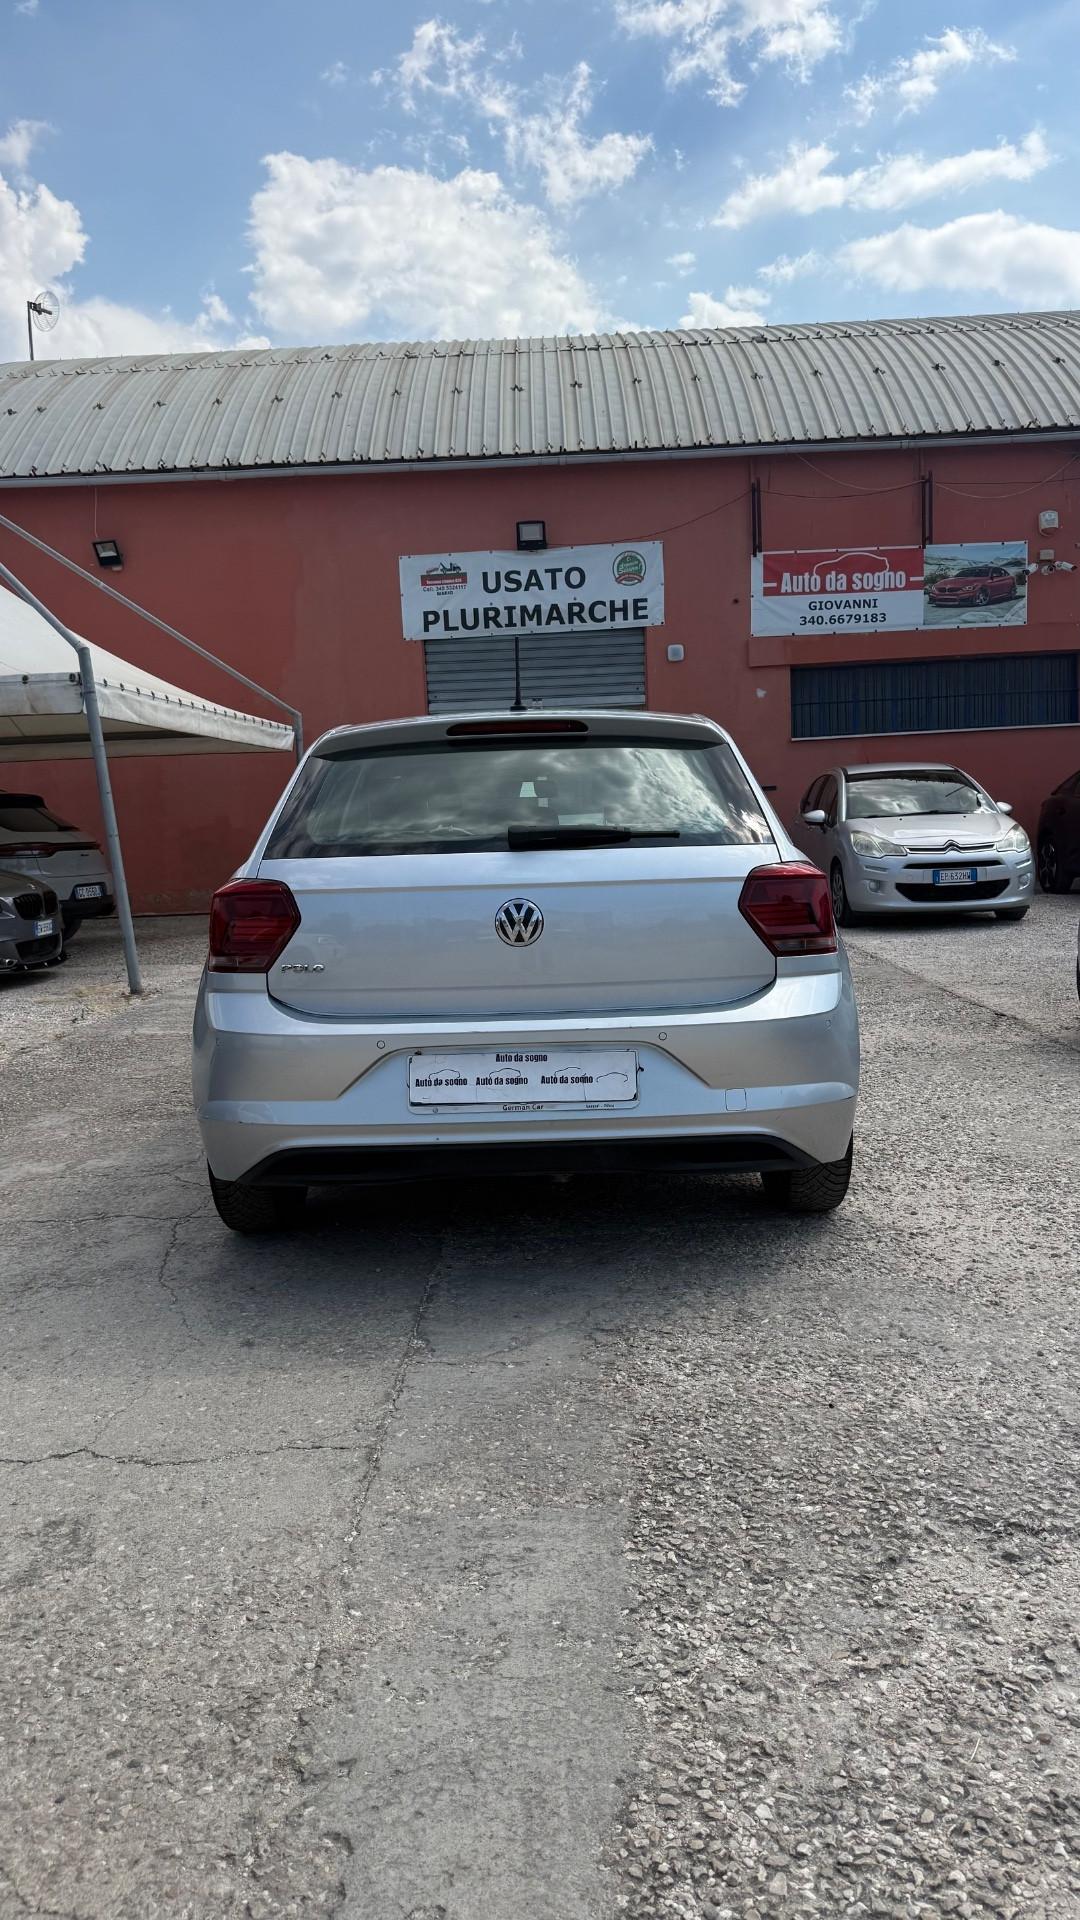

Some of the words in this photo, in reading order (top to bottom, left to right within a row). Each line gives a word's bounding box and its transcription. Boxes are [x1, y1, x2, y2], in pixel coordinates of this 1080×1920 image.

[482, 566, 586, 594] USATO
[781, 572, 821, 593] Auto
[825, 571, 847, 591] da
[851, 570, 906, 591] sogno
[808, 598, 878, 611] GIOVANNI
[423, 598, 649, 633] PLURIMARCHE
[799, 612, 887, 626] 340.6679183
[495, 1053, 512, 1062] Auto
[514, 1053, 523, 1062] da
[525, 1053, 548, 1063] sogno
[415, 1078, 432, 1087] Auto
[434, 1077, 442, 1086] da
[444, 1077, 468, 1087] sogno
[476, 1076, 493, 1086] Auto
[494, 1076, 504, 1085] da
[505, 1076, 528, 1087] sogno
[541, 1075, 557, 1084] Auto
[559, 1075, 568, 1084] da
[570, 1074, 593, 1084] sogno
